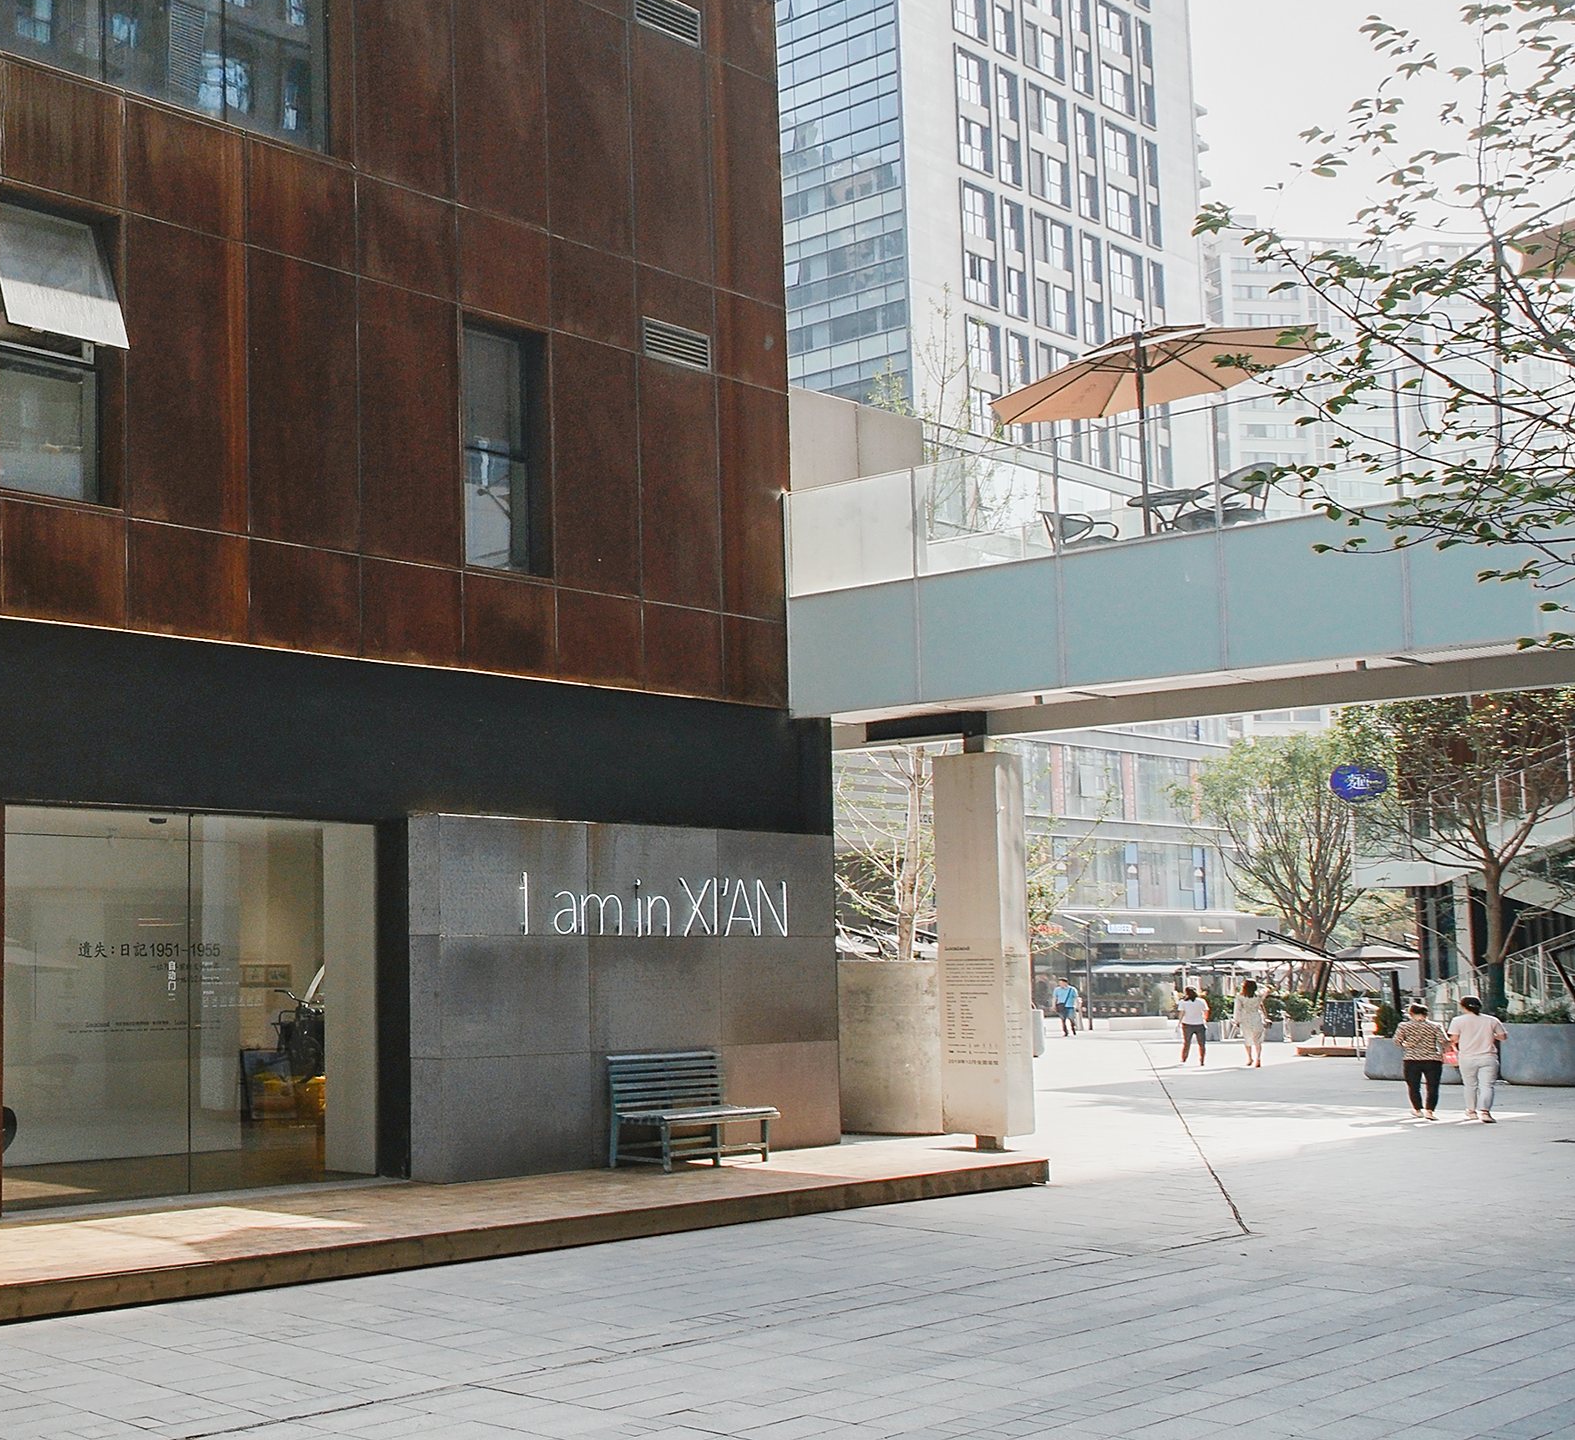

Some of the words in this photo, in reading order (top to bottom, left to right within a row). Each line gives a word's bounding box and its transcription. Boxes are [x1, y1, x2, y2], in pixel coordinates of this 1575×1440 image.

[519, 871, 529, 936] I
[554, 890, 623, 936] am
[635, 878, 671, 937] in
[679, 876, 788, 937] XI'AN
